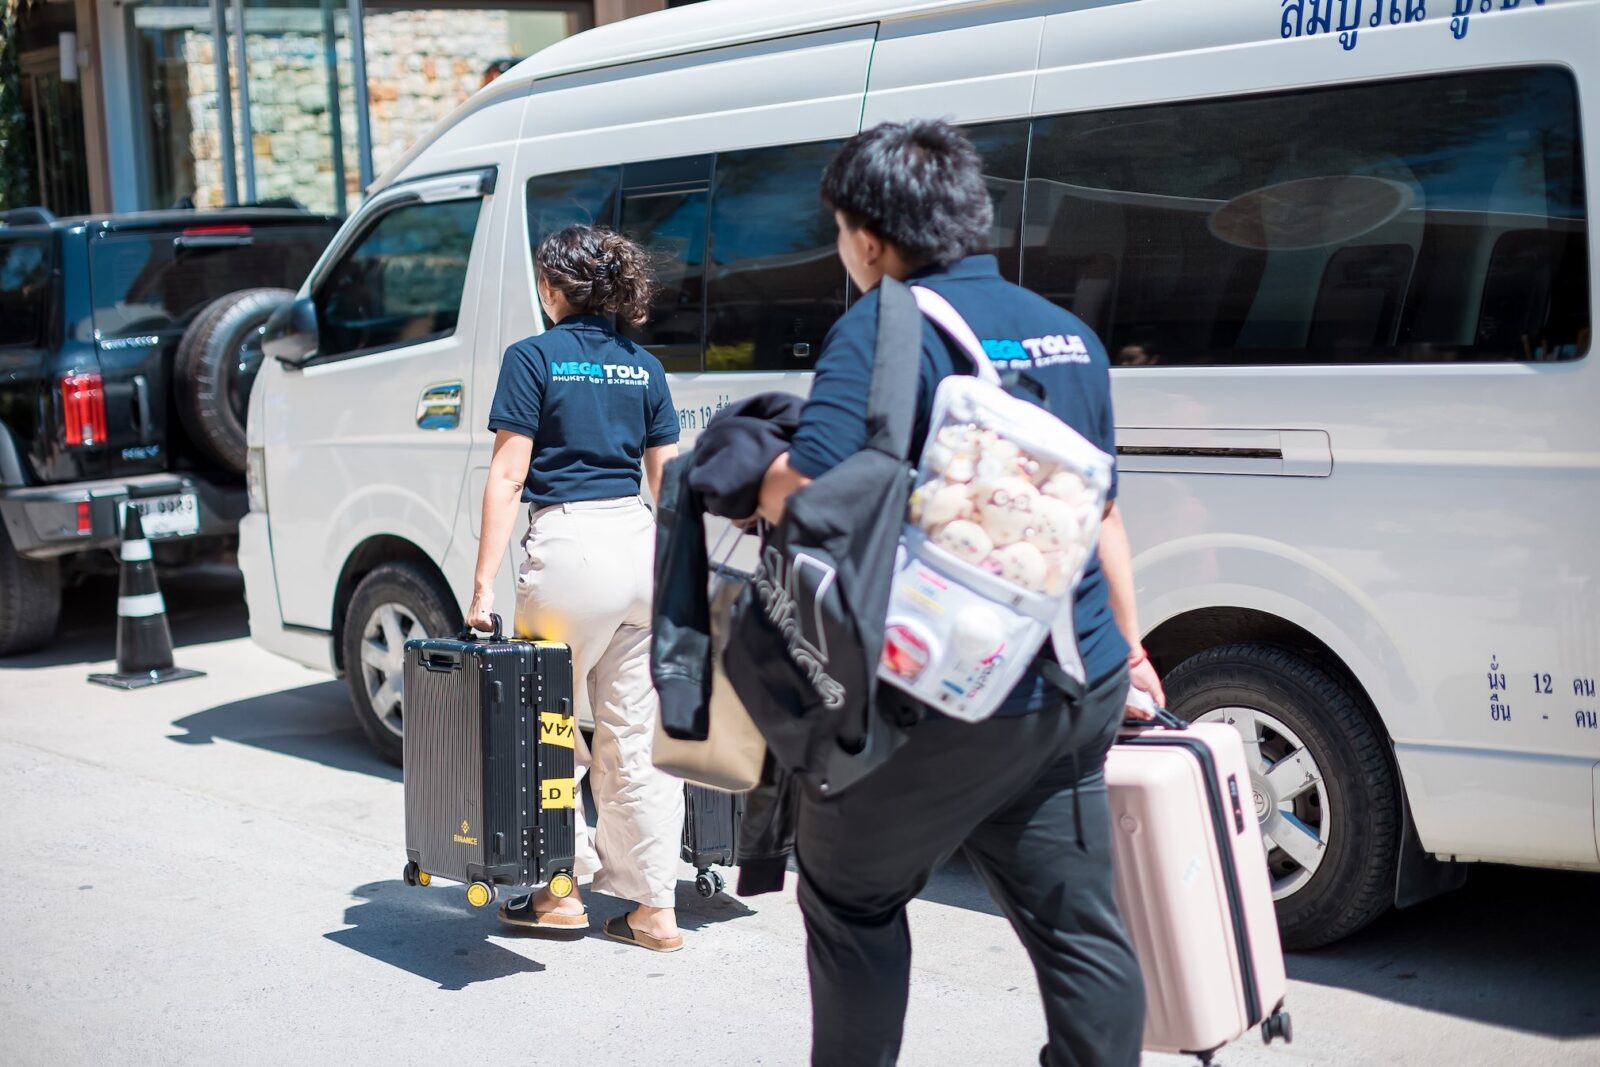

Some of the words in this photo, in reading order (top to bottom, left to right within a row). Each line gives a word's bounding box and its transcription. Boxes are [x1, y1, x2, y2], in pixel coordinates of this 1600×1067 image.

[607, 378, 649, 387] EXPERIEN
[1487, 654, 1506, 691] นั่ง
[1533, 673, 1553, 694] 12
[1573, 678, 1596, 697] คน
[1490, 693, 1511, 721] ยืน
[1575, 710, 1598, 729] คน
